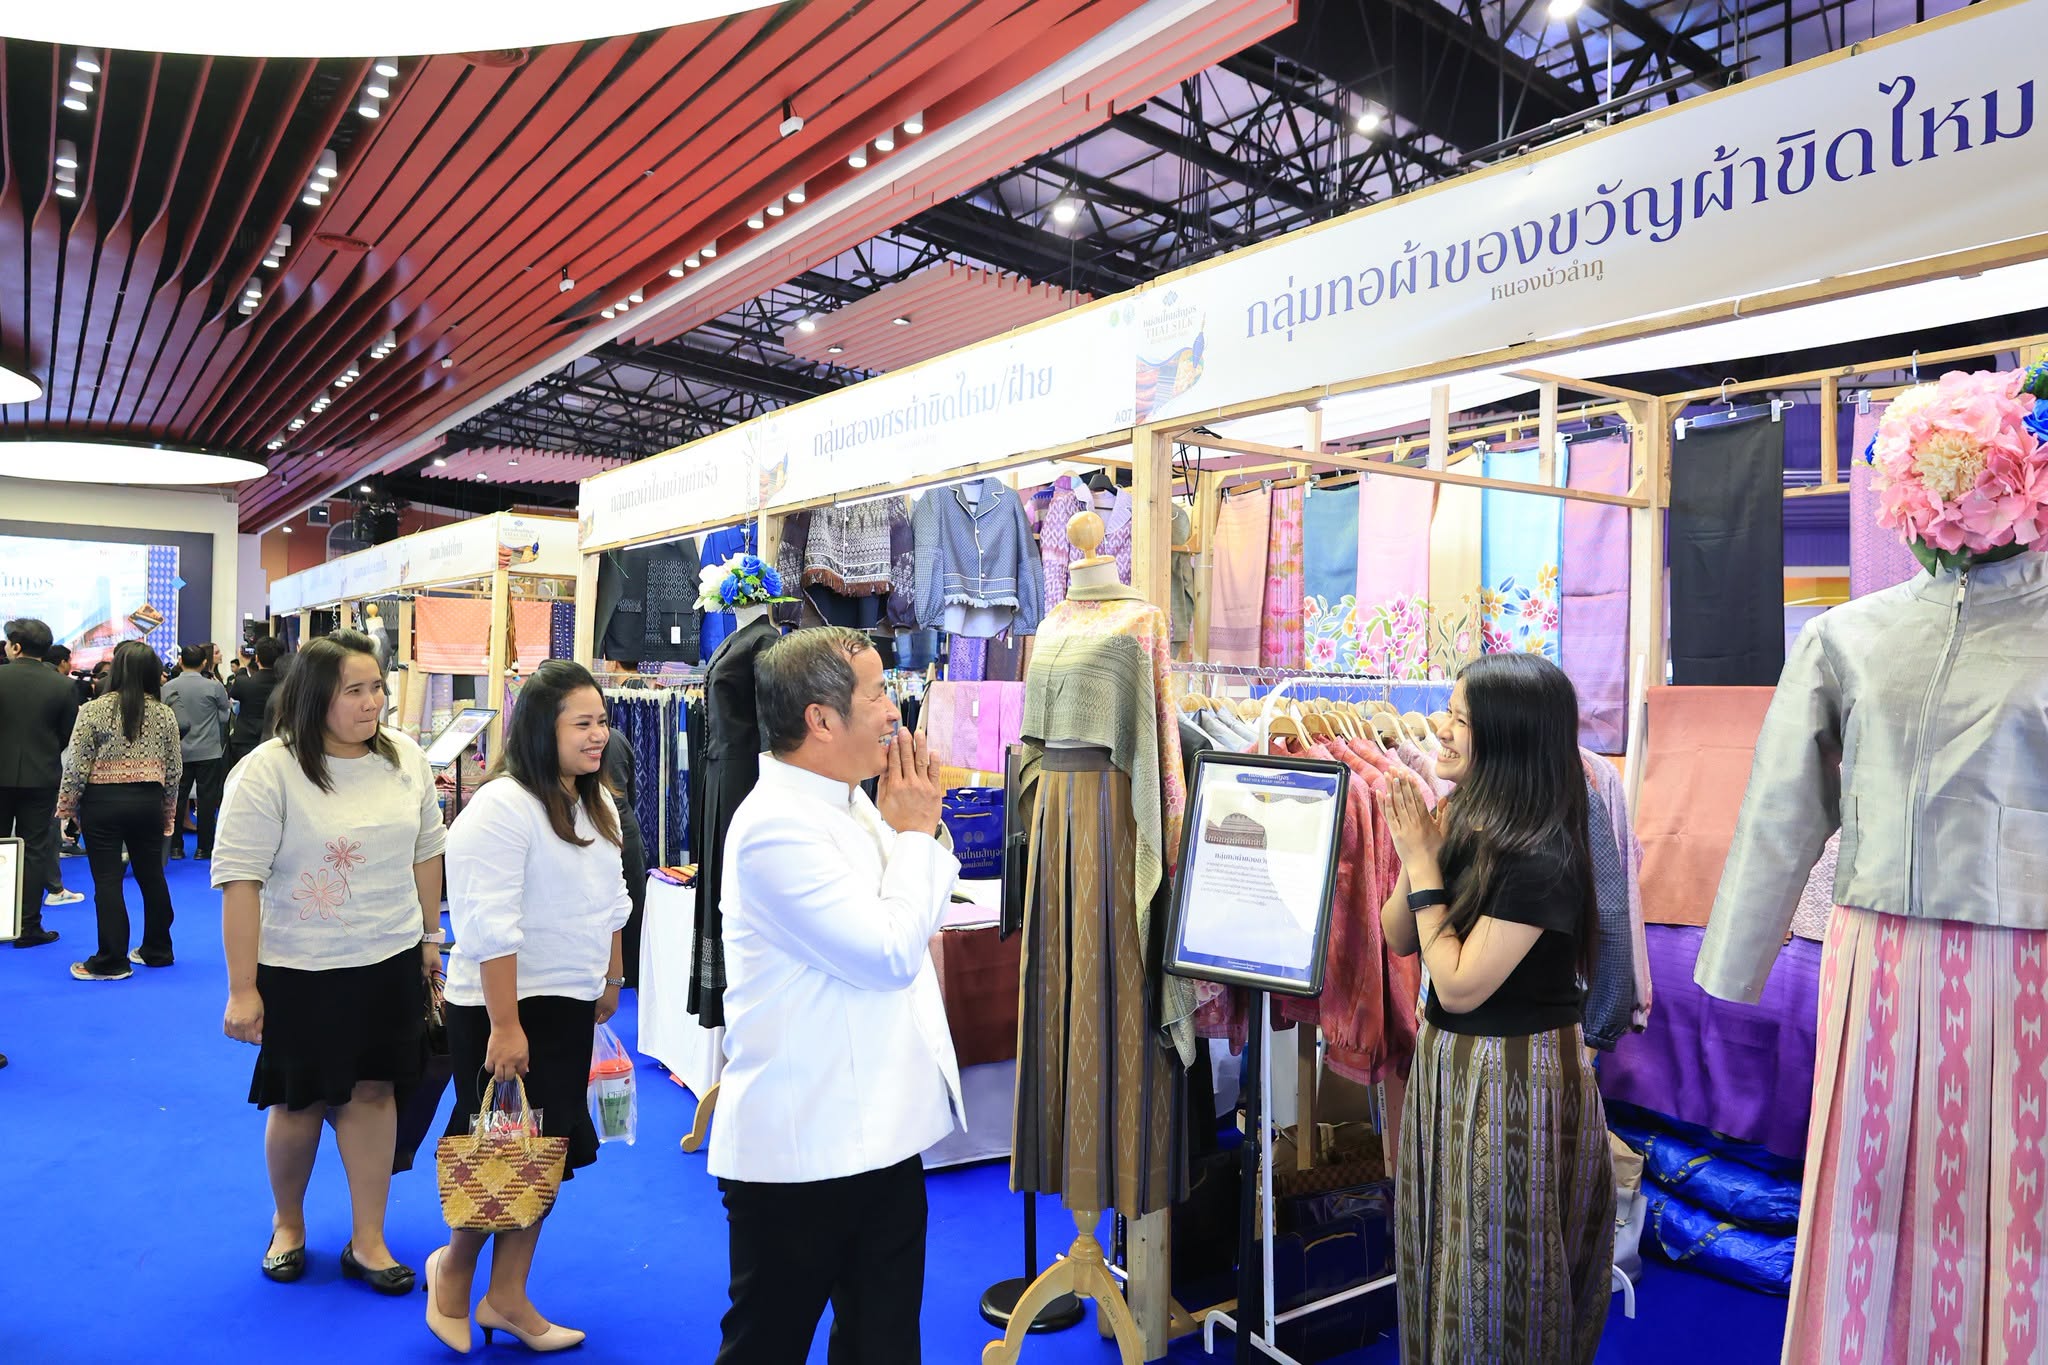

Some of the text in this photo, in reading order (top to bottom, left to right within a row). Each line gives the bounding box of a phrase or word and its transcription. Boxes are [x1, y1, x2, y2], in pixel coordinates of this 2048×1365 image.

[1245, 74, 2037, 343] กลุ่มทอผ้าของขวัญผ้าขิดไหม
[1489, 257, 1605, 302] หนองบัวลำภู
[1114, 408, 1133, 424] A07
